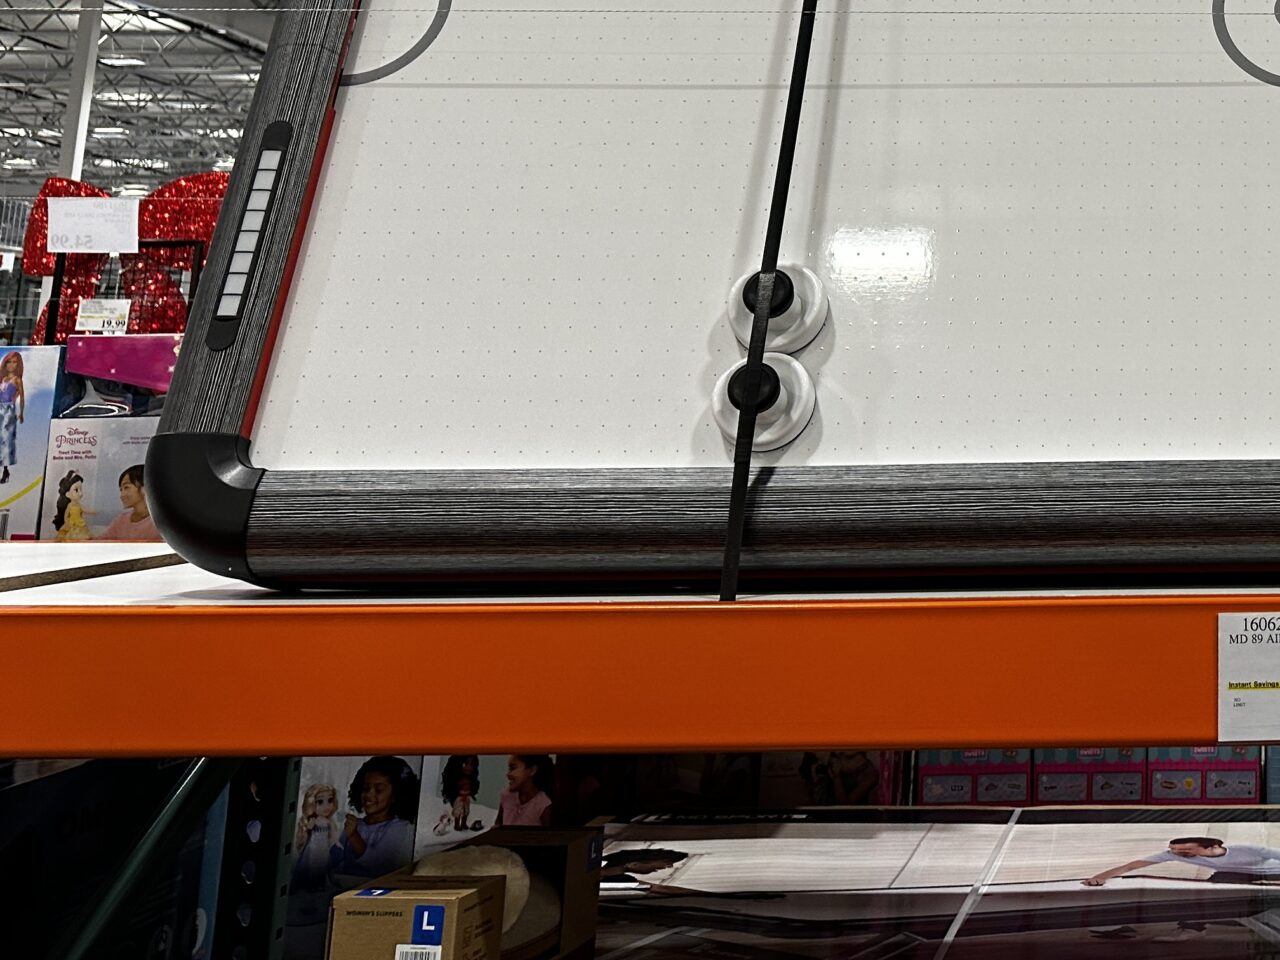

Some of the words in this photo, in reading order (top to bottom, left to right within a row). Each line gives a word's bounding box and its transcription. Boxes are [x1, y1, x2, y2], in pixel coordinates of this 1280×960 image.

[101, 319, 126, 328] 19.99
[1229, 634, 1248, 644] MD
[1252, 634, 1264, 644] 89
[1253, 680, 1280, 689] Savings
[422, 911, 436, 930] L
